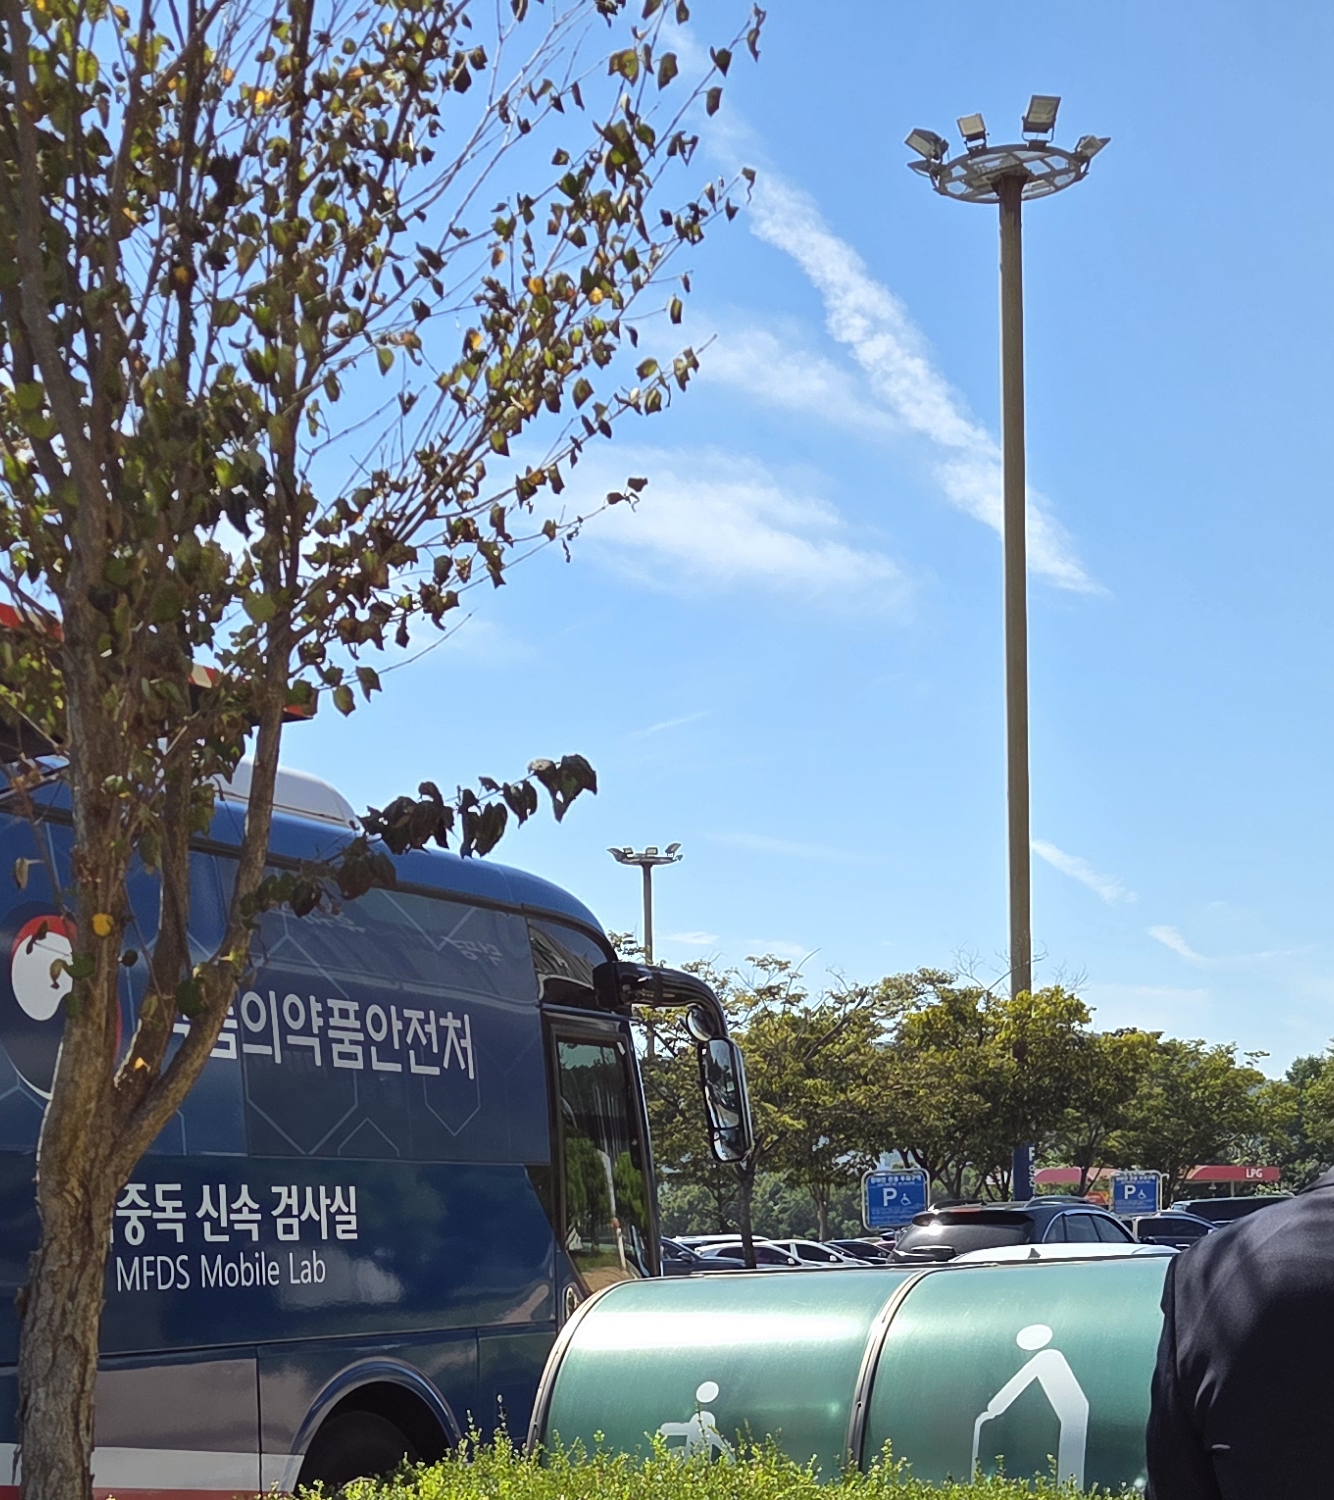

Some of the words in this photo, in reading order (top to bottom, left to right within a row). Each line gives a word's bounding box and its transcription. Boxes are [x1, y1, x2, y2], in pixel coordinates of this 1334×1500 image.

[173, 990, 474, 1080] 의약품안전처
[1246, 1168, 1263, 1178] LPG
[883, 1187, 897, 1207] P
[1124, 1185, 1136, 1200] P
[110, 1183, 187, 1246] 중독
[196, 1183, 262, 1242] 신속
[271, 1184, 358, 1241] 검사실
[116, 1255, 191, 1292] MFDS
[200, 1250, 280, 1289] Mobile
[289, 1250, 327, 1285] Lab
